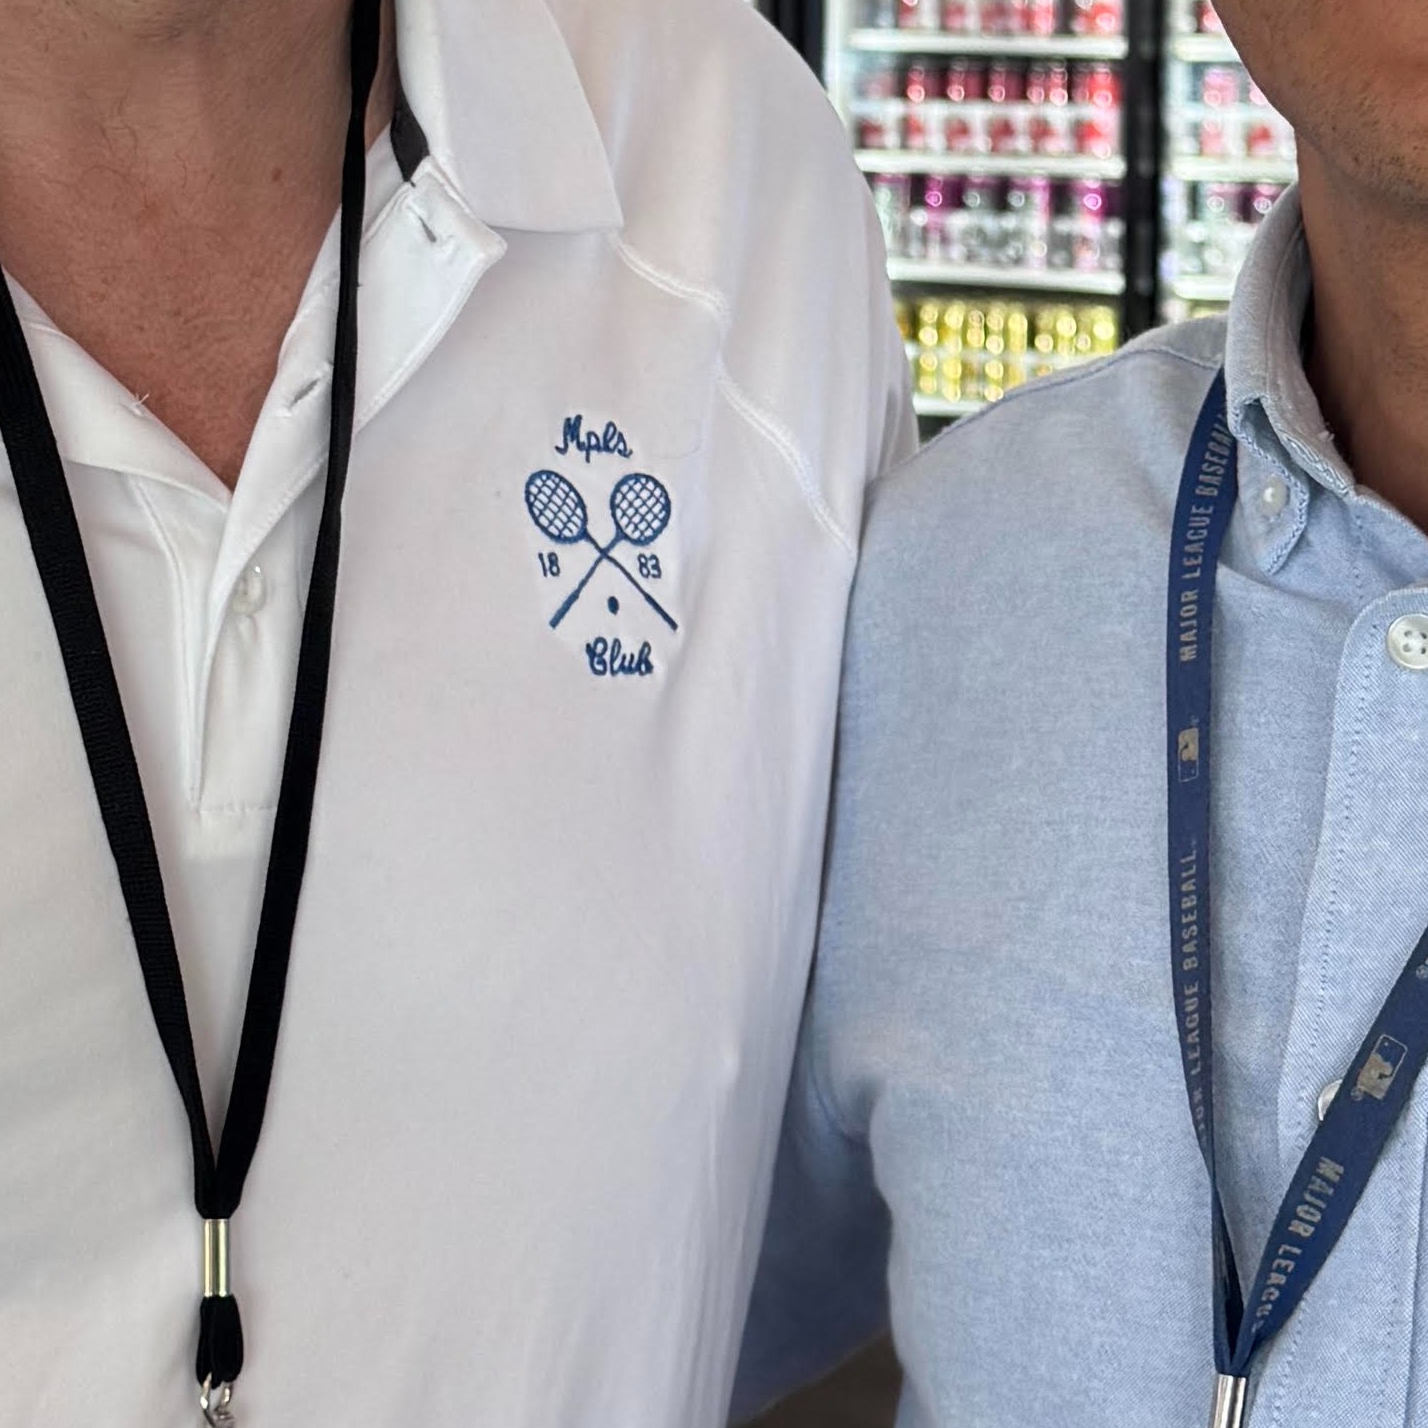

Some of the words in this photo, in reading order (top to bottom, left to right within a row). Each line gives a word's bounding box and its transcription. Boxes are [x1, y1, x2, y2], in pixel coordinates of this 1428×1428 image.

[555, 414, 633, 463] Mpls
[538, 551, 561, 577] 18
[637, 553, 662, 579] 83
[1182, 505, 1213, 580] LEAGUE
[585, 636, 654, 677] Club
[1180, 588, 1199, 663] MAJOR
[1183, 980, 1202, 1075] LEAGUE
[1288, 1156, 1345, 1238] MAJOR
